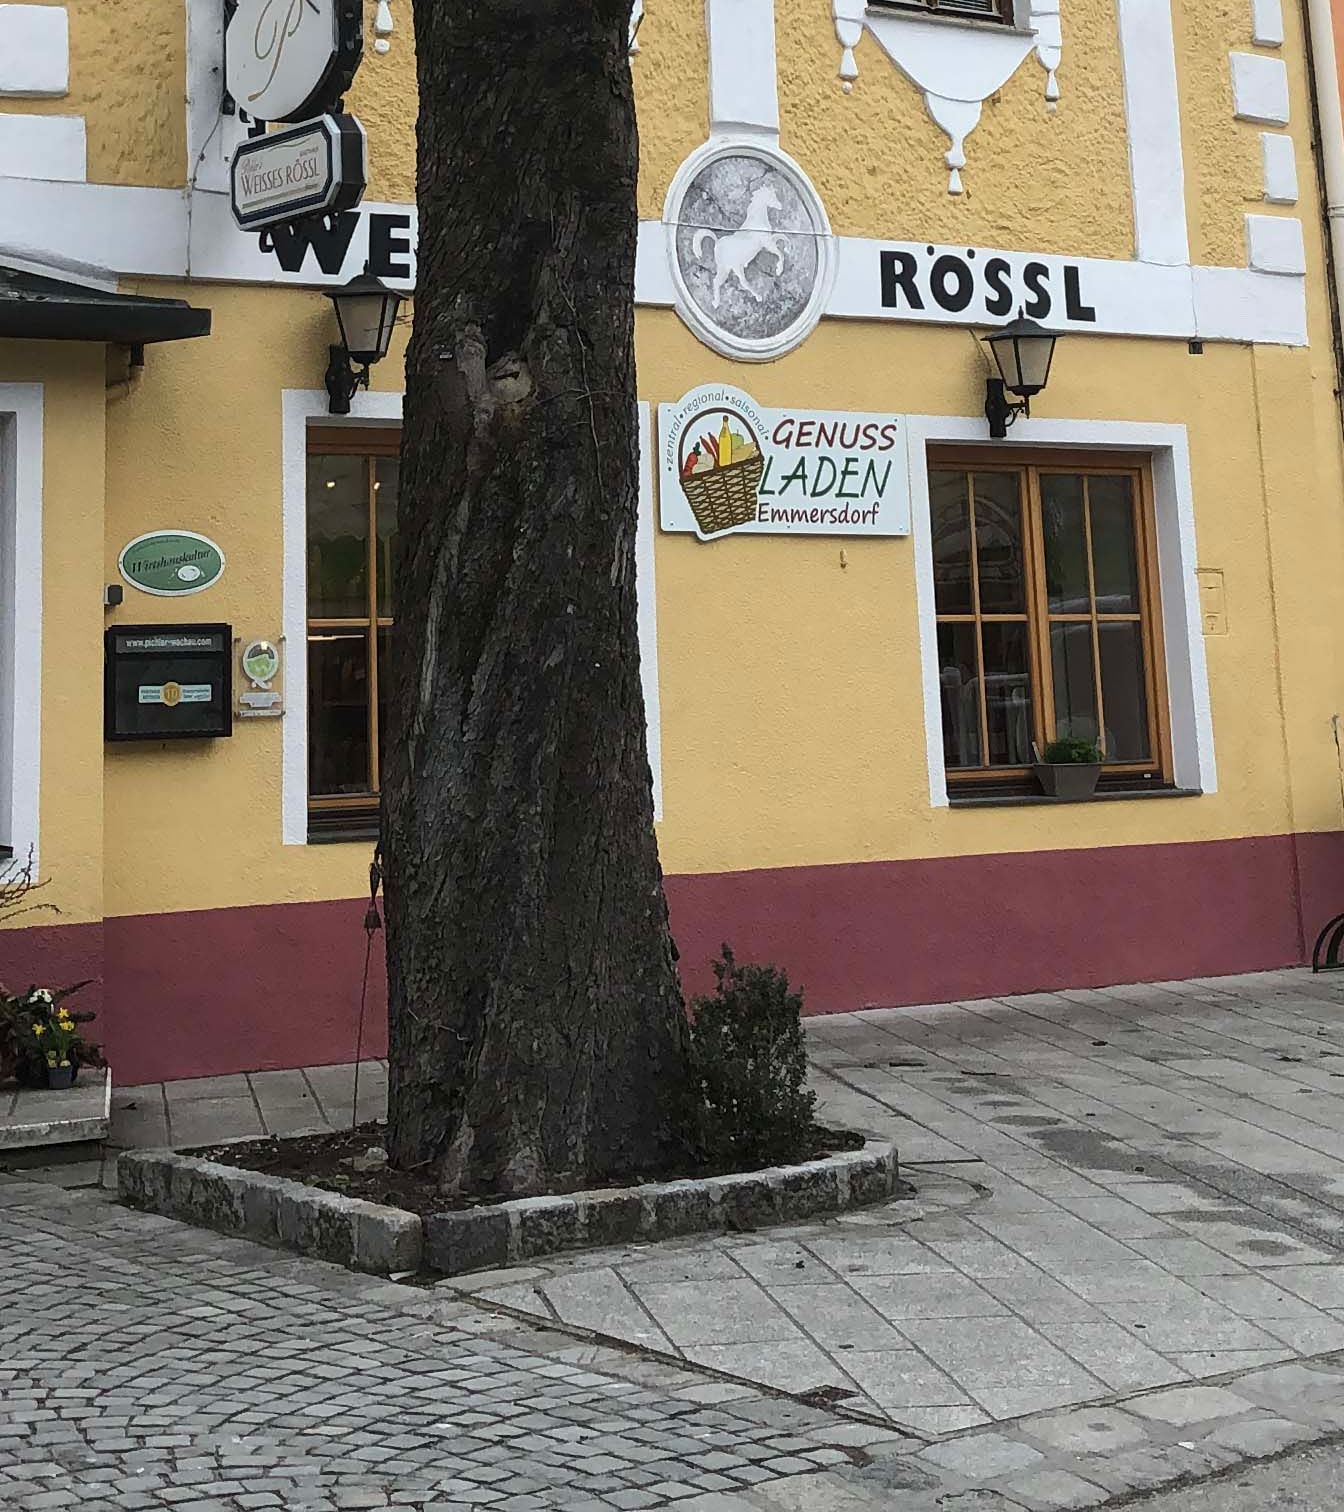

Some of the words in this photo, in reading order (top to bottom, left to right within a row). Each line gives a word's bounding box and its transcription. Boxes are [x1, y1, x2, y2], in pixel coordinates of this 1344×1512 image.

[240, 167, 284, 197] WEISSES
[285, 157, 320, 185] RÖSSL
[880, 245, 1096, 322] RÖSSL
[666, 414, 683, 466] zentral
[683, 390, 727, 417] regional
[730, 395, 768, 436] saisonal
[772, 418, 897, 451] GENUSS
[758, 455, 892, 499] LADEN
[758, 502, 880, 525] Emmersdorf
